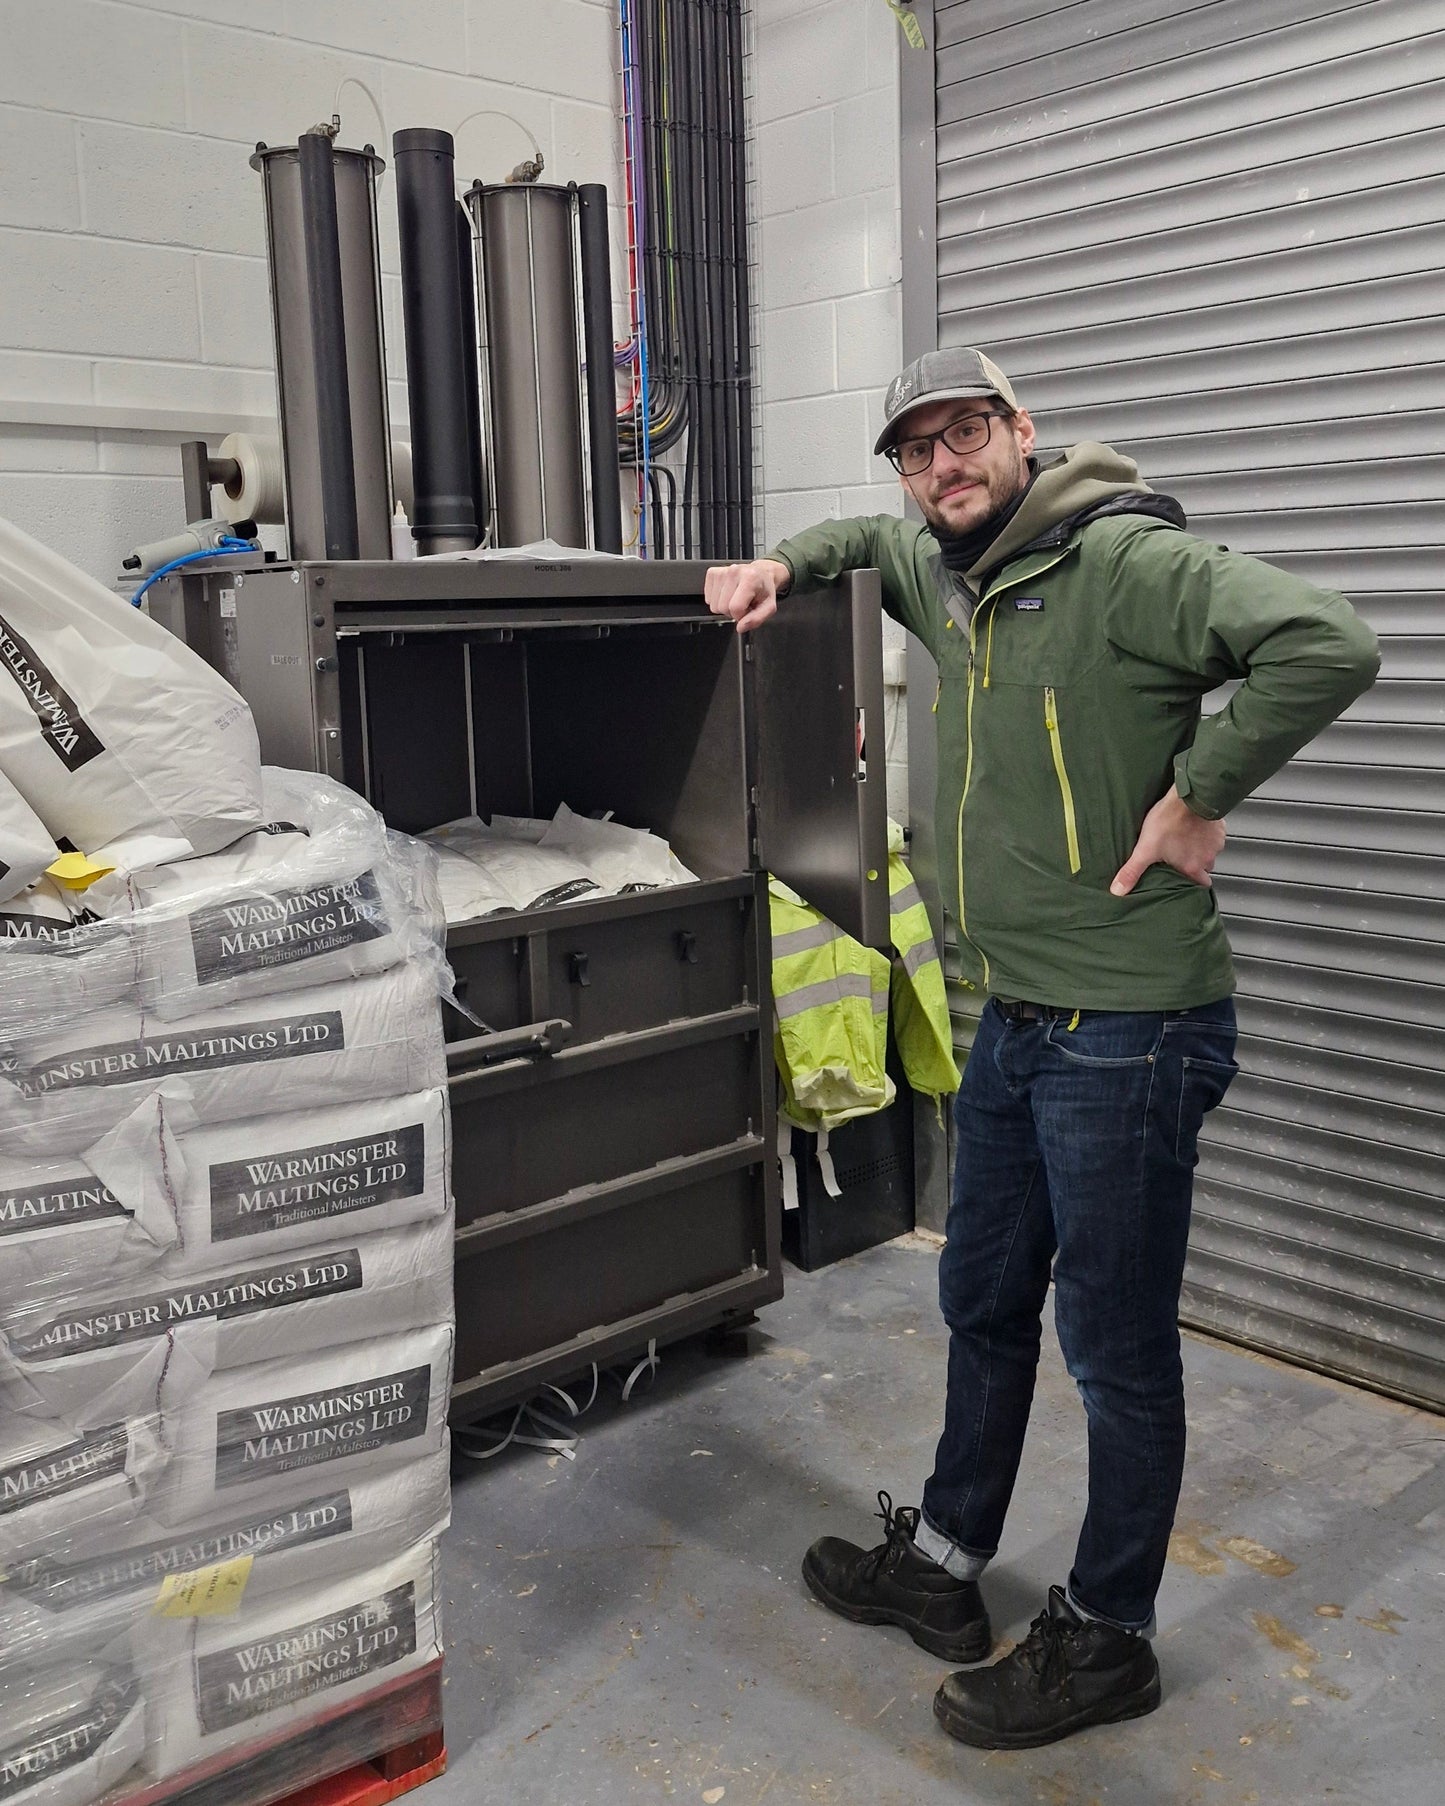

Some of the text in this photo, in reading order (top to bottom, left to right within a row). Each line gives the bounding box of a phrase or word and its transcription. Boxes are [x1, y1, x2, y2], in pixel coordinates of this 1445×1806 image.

[222, 880, 363, 929] WARMINSTER
[219, 915, 337, 958] MALTINGS
[257, 933, 354, 967] Traditional Maltsters
[144, 1031, 278, 1067] MALTINGS
[282, 1023, 330, 1046] LTD
[246, 1139, 399, 1186] WARMINSTER
[236, 1162, 407, 1215] MALTINGS LTD
[272, 1192, 377, 1225] Traditional Maltsters
[166, 1274, 297, 1320] MALTINGS
[301, 1263, 349, 1288] LTD
[252, 1382, 405, 1433] WARMINSTER
[242, 1405, 412, 1464] MALTINGS LTD
[277, 1449, 333, 1471] Traditional
[153, 1519, 285, 1573] MALTINGS
[289, 1505, 337, 1534] LTD
[226, 1625, 399, 1706] MALTINGS LTD
